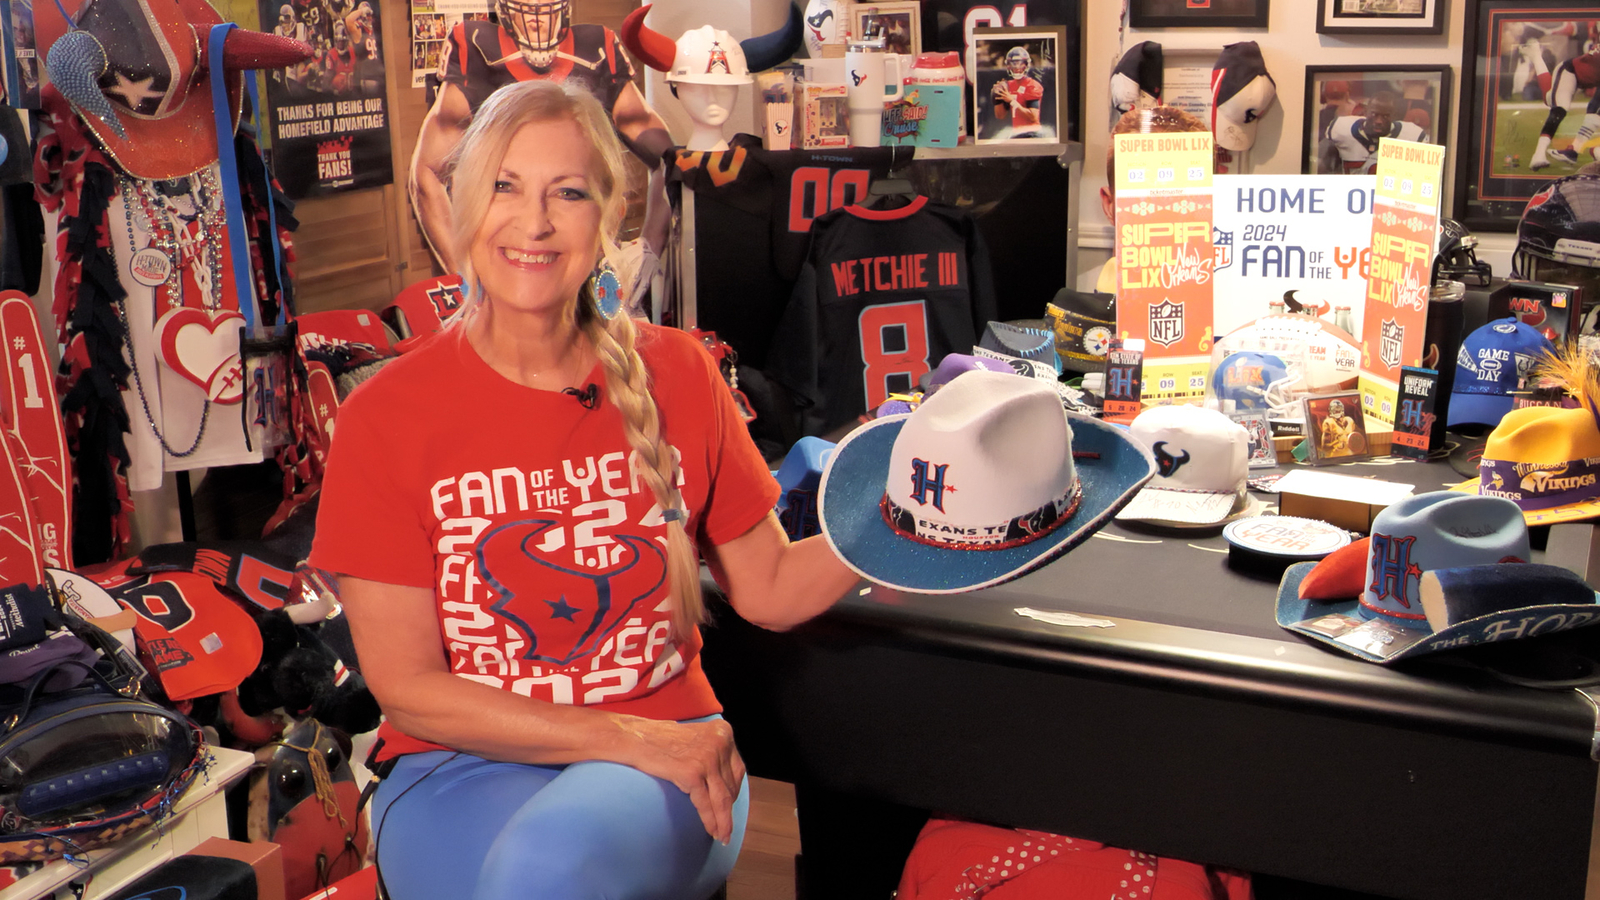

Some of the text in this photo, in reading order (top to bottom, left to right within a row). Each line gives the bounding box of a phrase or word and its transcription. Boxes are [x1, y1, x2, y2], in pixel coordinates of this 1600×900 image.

[302, 6, 319, 26] 59
[277, 98, 382, 121] THANKS FOR BEING OUR
[902, 105, 929, 120] SAID!
[278, 114, 384, 139] HOMEFIELD ADVANTAGE
[885, 121, 918, 137] Cruise
[1120, 138, 1210, 152] SUPER BOWL LIX
[317, 150, 351, 162] THANK YOU
[1381, 144, 1441, 166] SUPER BOWL LIX
[318, 159, 352, 179] FANS!
[1129, 169, 1203, 180] 02 09 25
[1384, 178, 1432, 195] 02 09 25
[1237, 187, 1325, 214] HOME
[1121, 221, 1210, 246] SUPER
[1242, 224, 1287, 242] 2024
[1373, 232, 1430, 268] SUPER
[1568, 243, 1593, 251] TEXANS
[1121, 246, 1177, 268] BOWL
[1242, 245, 1305, 278] FAN
[1309, 251, 1324, 264] OF
[831, 252, 958, 297] METCHIE III
[1122, 267, 1161, 289] LIX
[1309, 266, 1332, 280] THE
[1370, 255, 1405, 285] BOWL
[1368, 277, 1394, 305] LIX
[1153, 320, 1180, 341] NFL
[858, 299, 931, 413] 8
[1381, 338, 1399, 362] NFL
[1478, 348, 1510, 361] GAME
[1335, 358, 1355, 368] YEAR
[1160, 380, 1175, 389] 09
[1190, 378, 1204, 387] 25
[1404, 376, 1433, 389] UNIFORM
[1477, 369, 1502, 382] DAY
[1404, 384, 1429, 397] REVEAL
[1364, 395, 1391, 413] 02 09
[1277, 424, 1300, 433] Riddell
[1417, 439, 1425, 447] 24
[909, 457, 950, 515] H
[1532, 473, 1596, 492] VIKINGS
[430, 467, 528, 521] FAN
[530, 469, 553, 488] OF
[533, 488, 569, 508] THE
[1481, 486, 1522, 501] VIKINGS
[1370, 533, 1416, 609] H
[1430, 635, 1469, 650] THE
